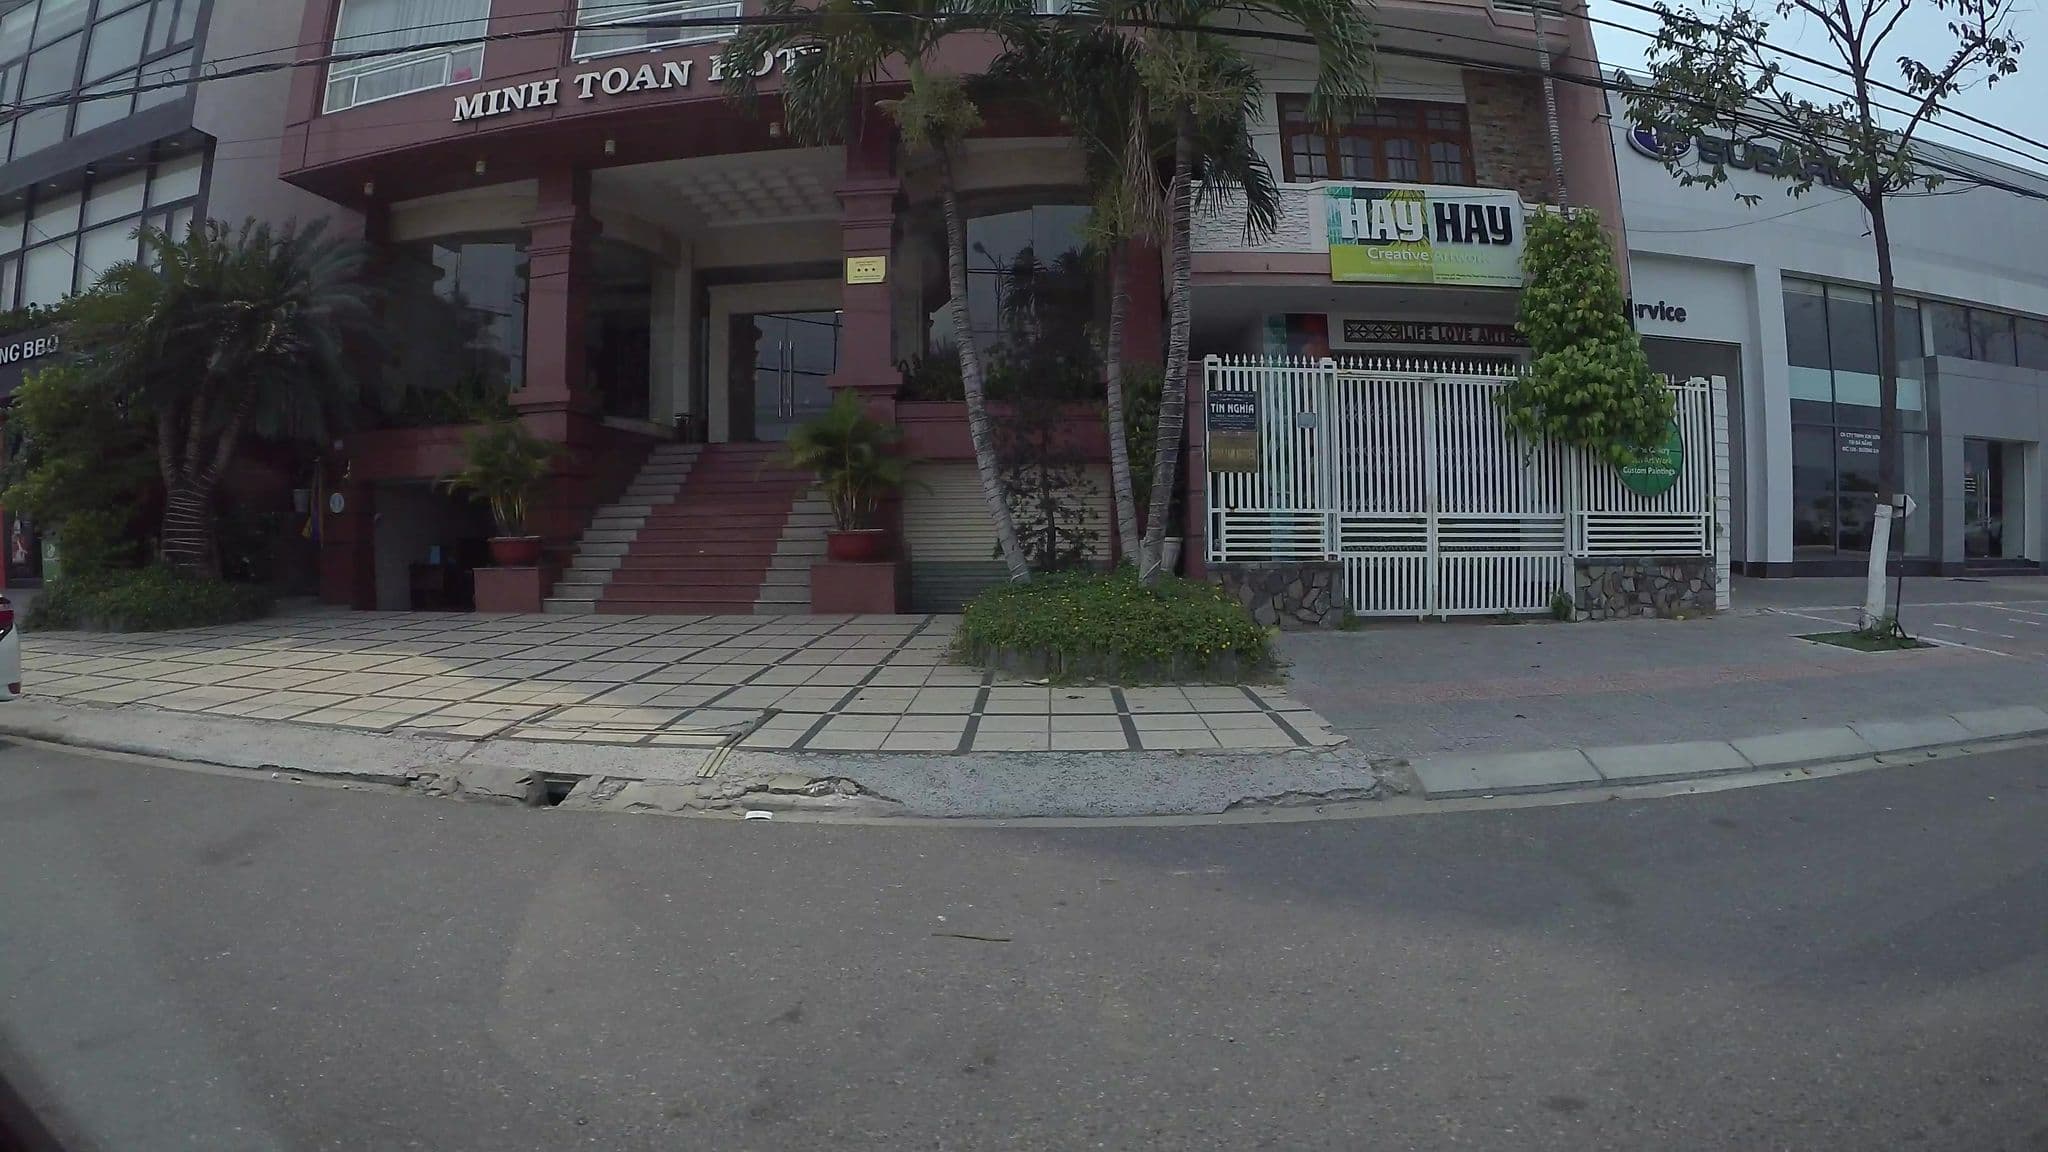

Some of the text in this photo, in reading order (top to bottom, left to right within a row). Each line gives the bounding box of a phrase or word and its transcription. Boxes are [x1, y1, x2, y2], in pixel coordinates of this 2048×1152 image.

[452, 43, 822, 122] MINH TOAN HOT
[1338, 198, 1513, 245] HAY HAY
[1367, 247, 1430, 261] Creative
[1404, 325, 1433, 341] LIFE
[1438, 326, 1473, 342] LOVE
[1623, 466, 1676, 476] Custom Paintings
